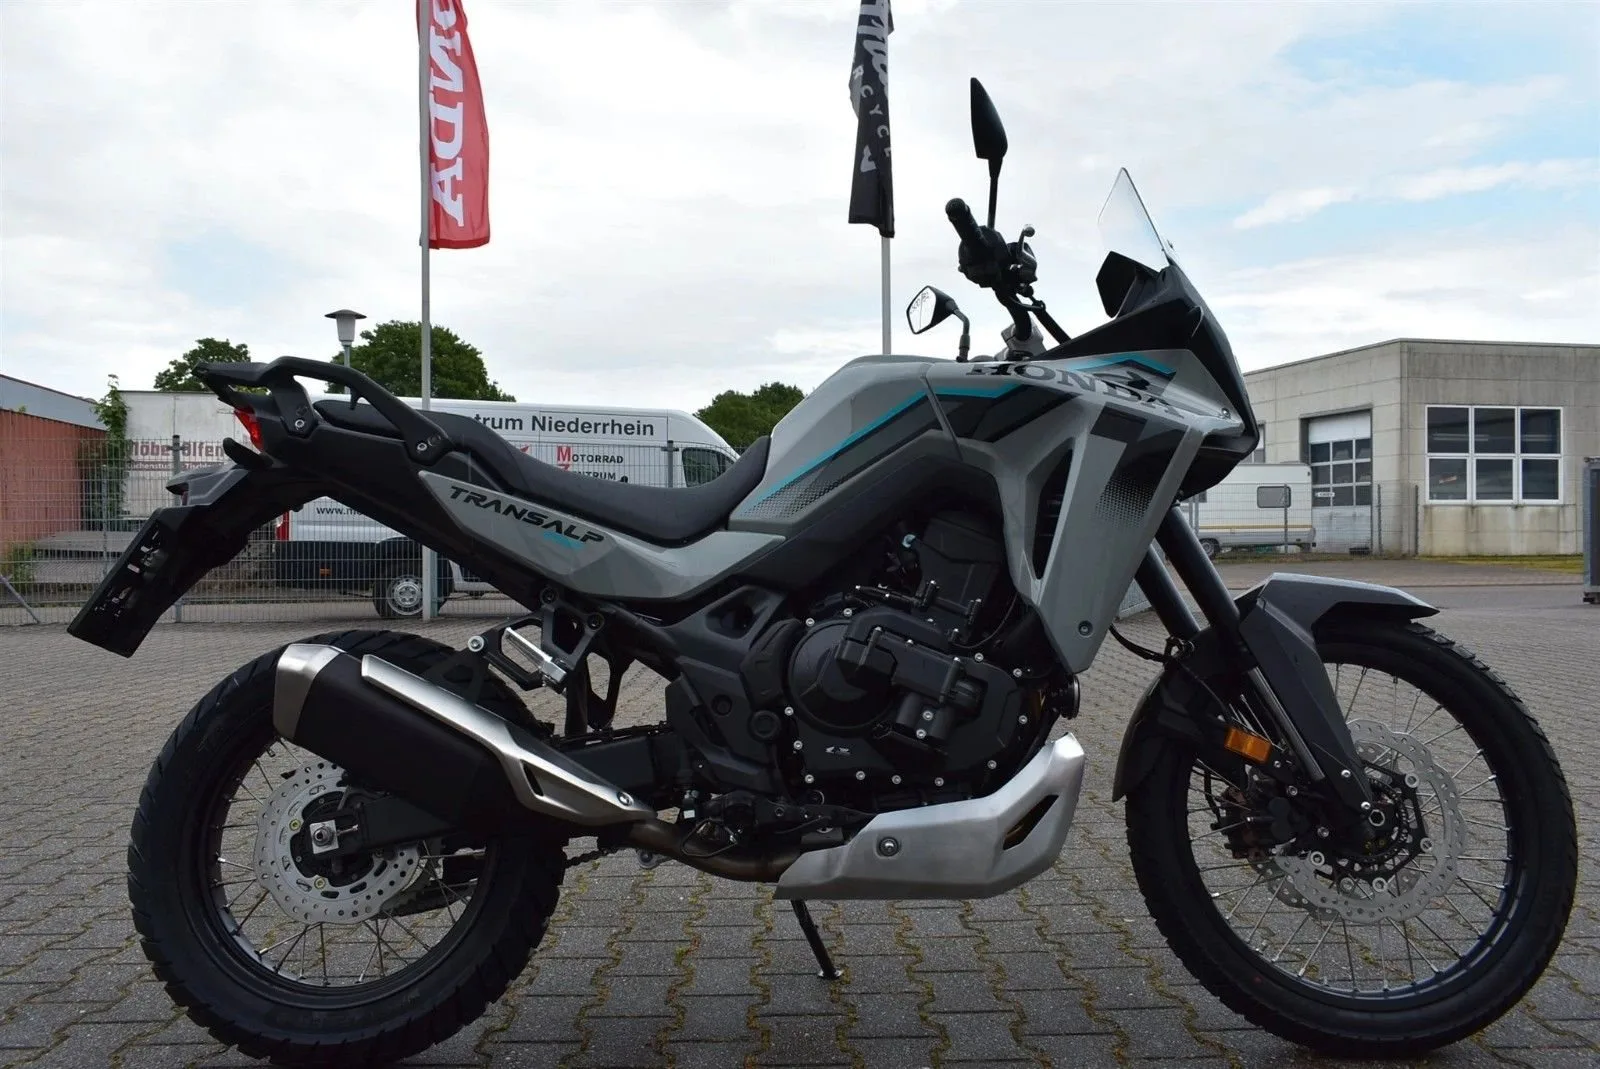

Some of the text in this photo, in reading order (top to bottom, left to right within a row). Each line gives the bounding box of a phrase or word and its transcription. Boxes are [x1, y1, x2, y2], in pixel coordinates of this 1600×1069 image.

[965, 363, 1186, 419] HONDA
[531, 415, 655, 436] Niederrhein
[450, 486, 605, 543] TRANSALP
